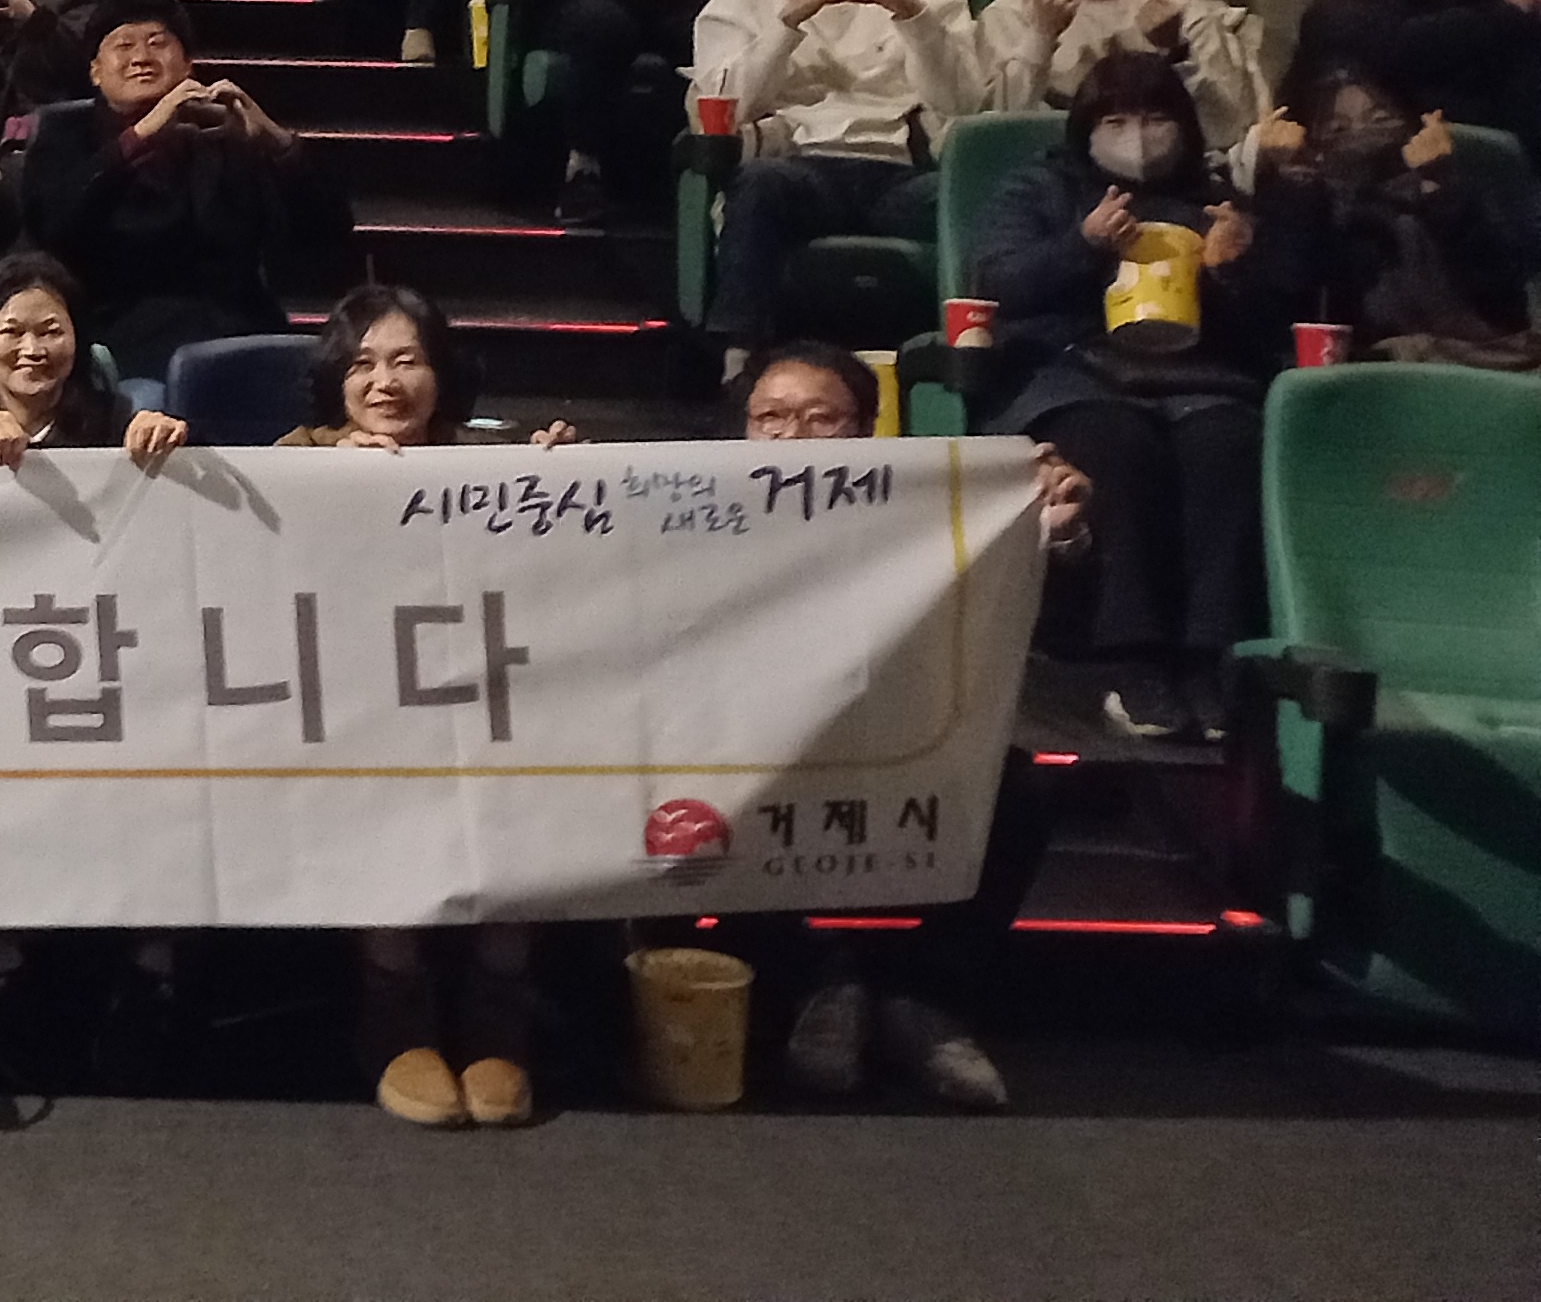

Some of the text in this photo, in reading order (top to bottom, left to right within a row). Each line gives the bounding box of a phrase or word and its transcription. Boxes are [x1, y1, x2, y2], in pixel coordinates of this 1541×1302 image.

[400, 475, 614, 535] 시민중심
[661, 502, 750, 536] 새로운
[749, 464, 893, 521] 거제
